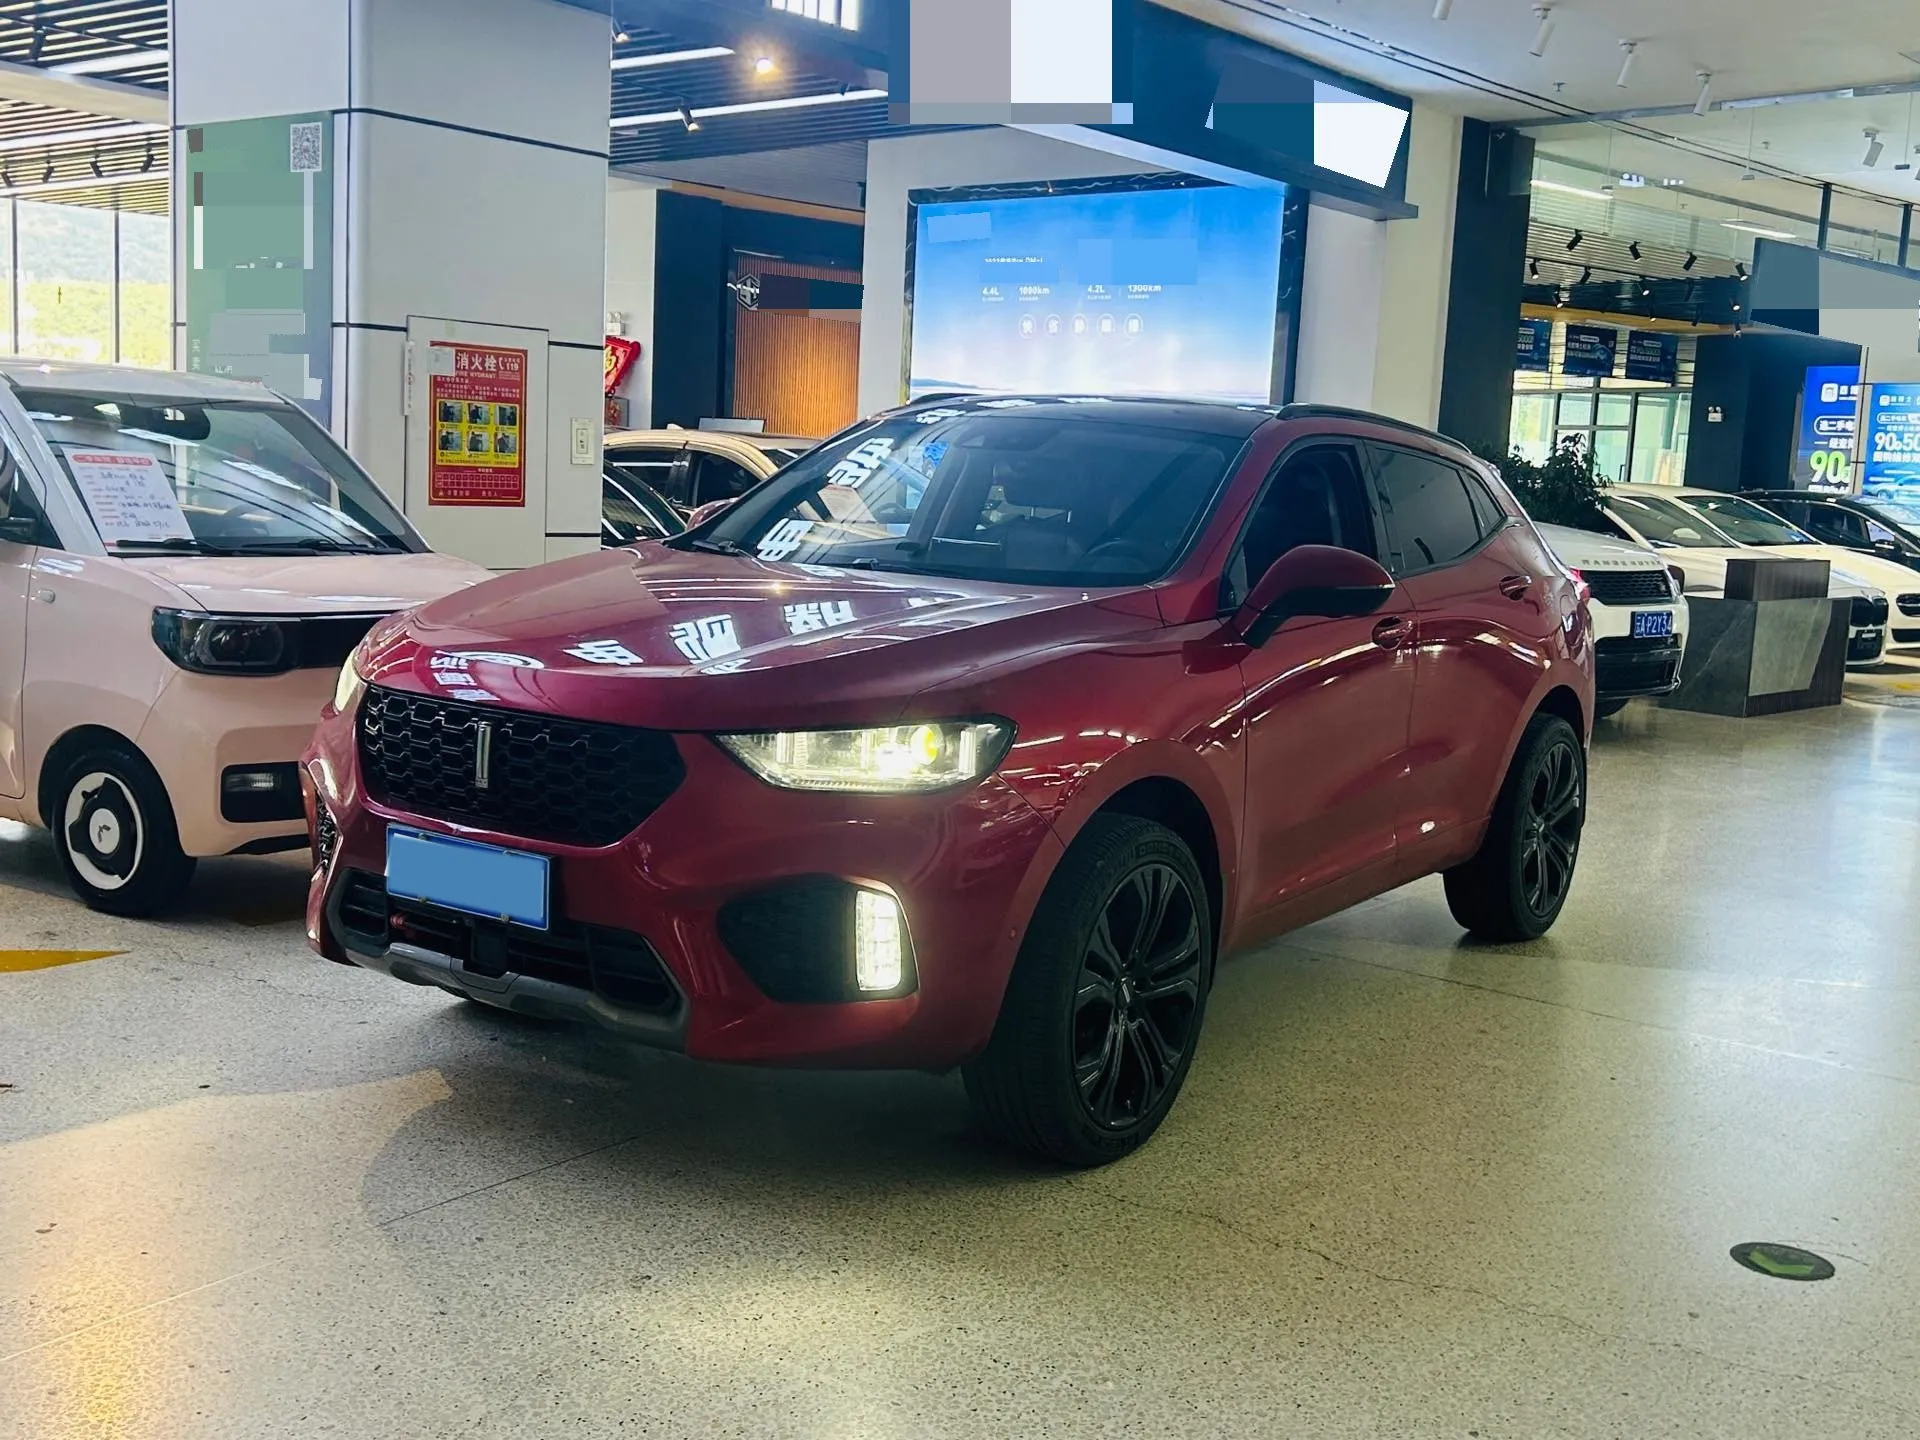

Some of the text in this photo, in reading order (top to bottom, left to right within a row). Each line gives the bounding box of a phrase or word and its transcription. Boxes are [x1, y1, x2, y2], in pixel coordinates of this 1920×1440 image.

[456, 352, 497, 372] 消火栓
[506, 362, 519, 371] 119
